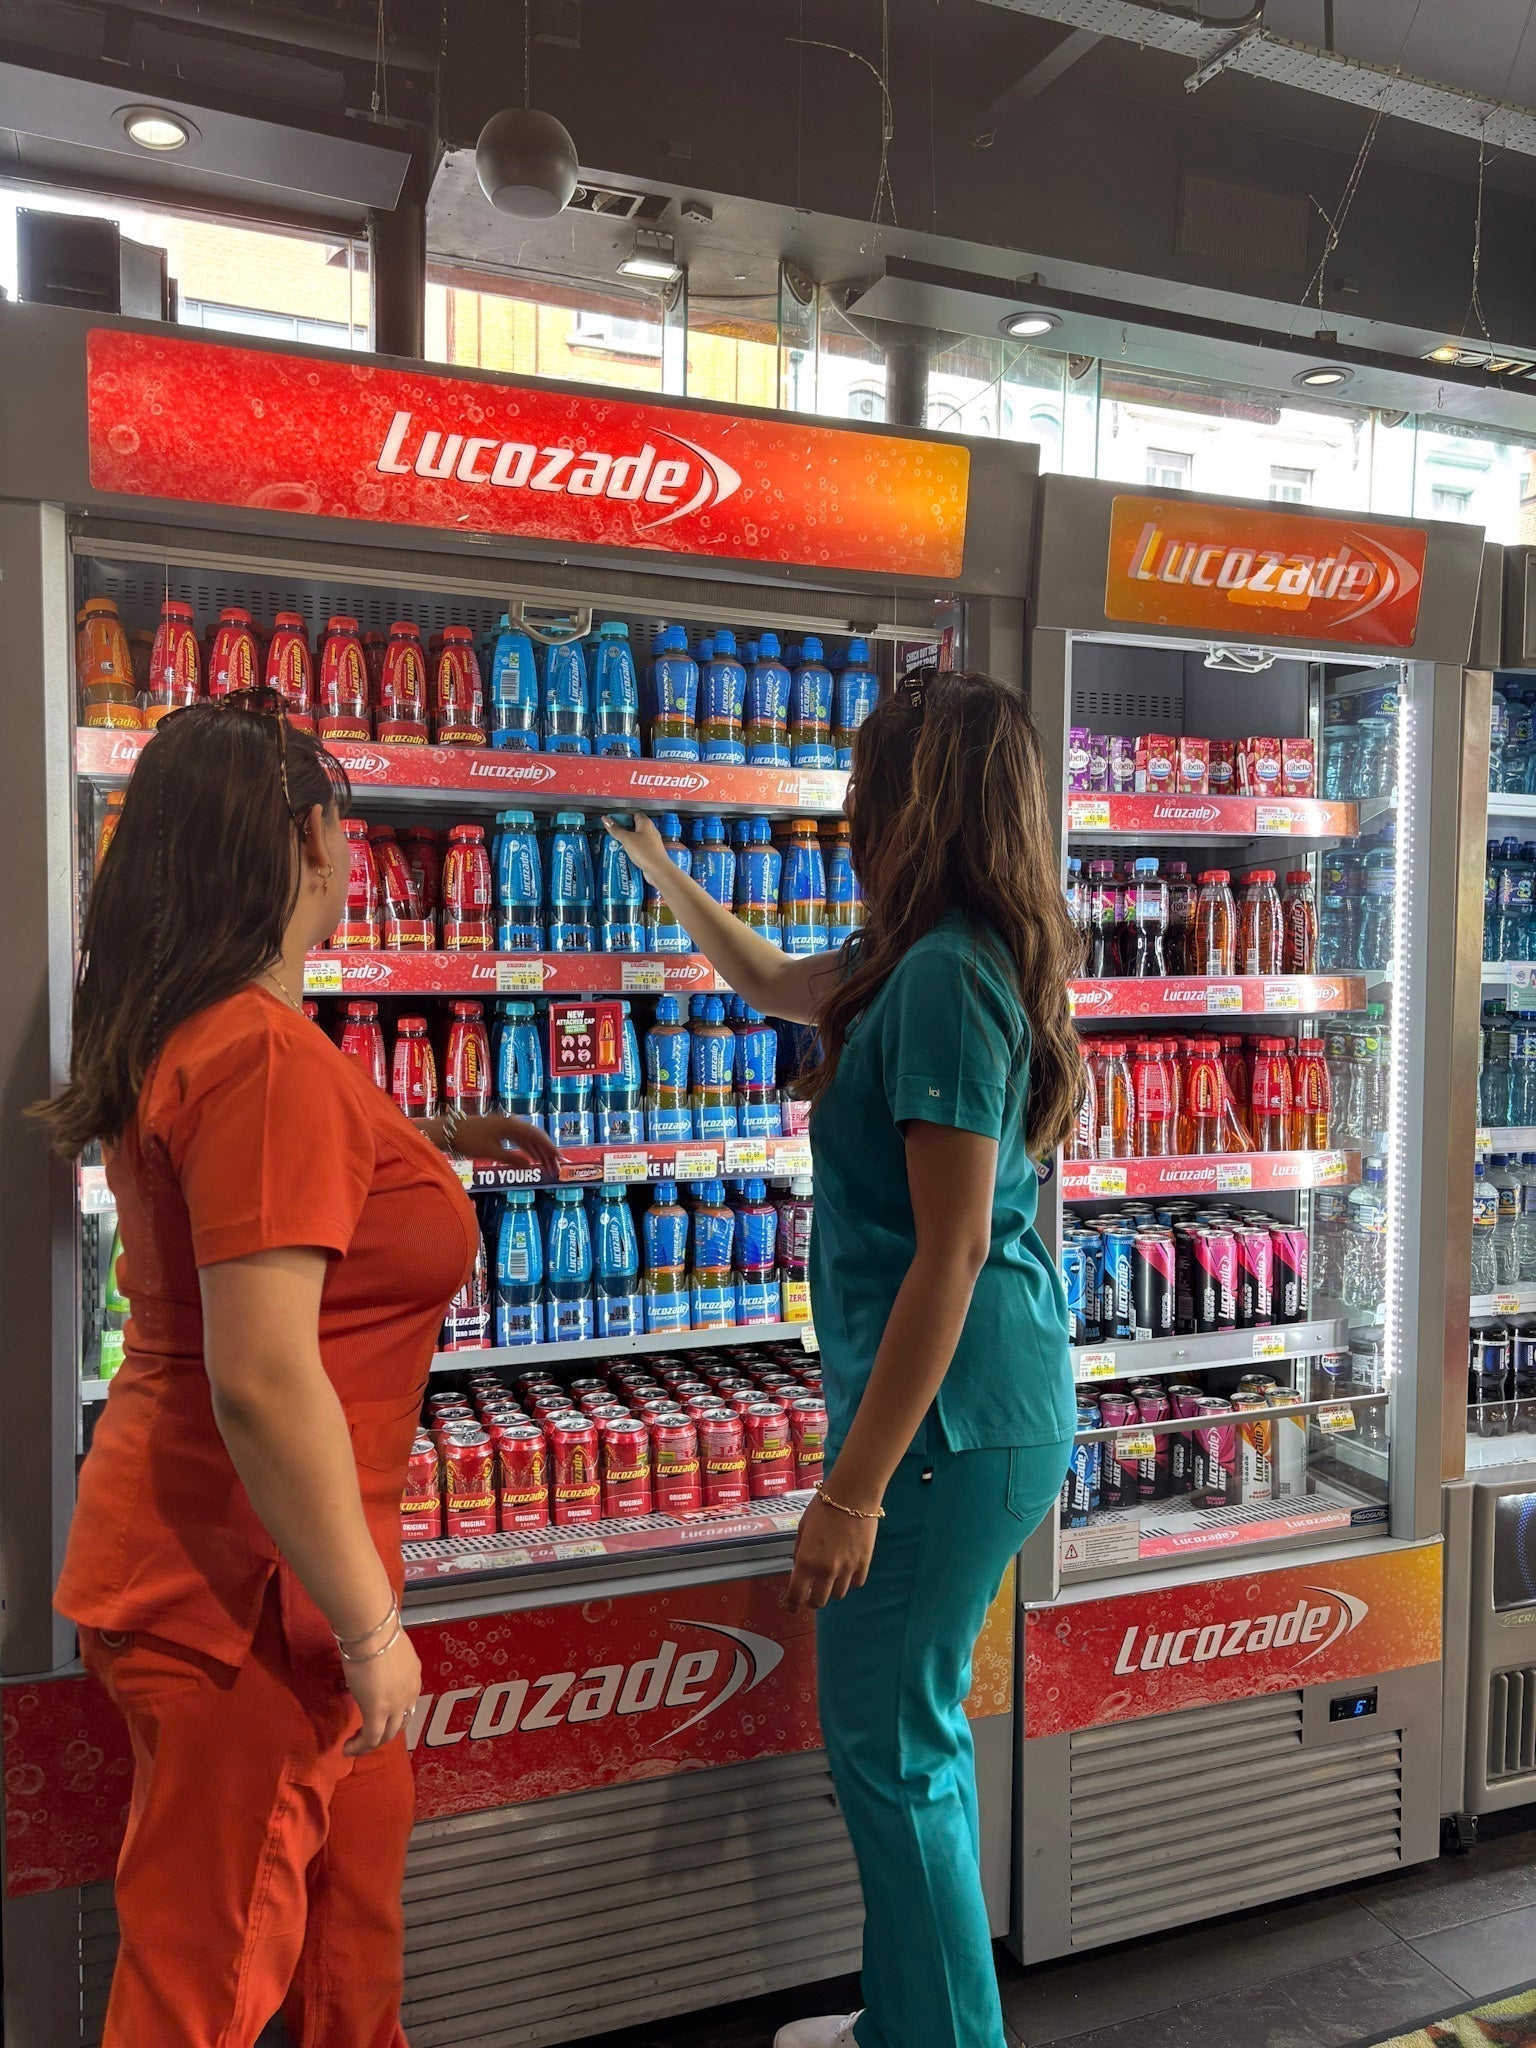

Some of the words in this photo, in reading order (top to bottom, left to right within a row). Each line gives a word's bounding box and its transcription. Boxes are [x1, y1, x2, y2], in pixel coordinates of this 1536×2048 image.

[375, 410, 686, 505] Lucozade
[1127, 521, 1378, 602] Lucozade
[322, 729, 366, 741] Lucozade
[381, 733, 424, 744] Lucozade
[439, 730, 482, 742] Lucozade
[656, 749, 697, 760] Lucozade
[702, 752, 744, 763] Lucozade
[750, 755, 791, 768] Lucozade
[794, 756, 834, 767] Lucozade
[1149, 760, 1171, 771] Ribena
[1183, 761, 1205, 772] Ribena
[1257, 761, 1279, 772] Ribena
[1286, 761, 1312, 772] Ribena
[470, 760, 543, 780] Lucozade
[1208, 764, 1231, 775] Ribena
[629, 770, 698, 788] Lucozade
[1154, 804, 1210, 819] Lucozade
[522, 852, 532, 897] Lucozade
[562, 851, 574, 896] Lucozade
[620, 852, 630, 896] Lucozade
[787, 937, 826, 947] Lucozade
[1292, 910, 1304, 967] Lucozade
[566, 1010, 585, 1019] NEW
[556, 1018, 583, 1026] ATTACHED
[467, 1041, 476, 1087] Lucozade
[710, 1044, 719, 1084] Lucozade
[742, 1116, 779, 1126] Lucozade
[477, 1171, 494, 1185] TO
[497, 1168, 541, 1184] YOURS
[1160, 1167, 1215, 1182] Lucozade
[567, 1229, 578, 1273] Lucozade
[612, 1224, 623, 1268] Lucozade
[1085, 1264, 1095, 1321] Lucozade
[1115, 1262, 1129, 1318] Lucozade
[1218, 1264, 1232, 1319] Lucozade
[1255, 1260, 1267, 1316] Lucozade
[695, 1298, 733, 1309] Lucozade
[738, 1294, 777, 1305] Lucozade
[444, 1314, 487, 1328] Lucozade
[751, 1447, 789, 1460] Lucozade
[798, 1451, 825, 1462] Lucoz
[1253, 1431, 1265, 1482] Lucozade
[657, 1461, 697, 1474] Lucozade
[706, 1457, 745, 1470] Lucozade
[1206, 1436, 1219, 1488] Lucozade
[606, 1466, 648, 1480] Lucozade
[1112, 1462, 1122, 1488] ALERT
[1217, 1467, 1227, 1492] ALERT
[763, 1477, 787, 1485] ORIGINAL
[1072, 1456, 1086, 1511] Lucozade
[503, 1490, 545, 1503] Lucozade
[555, 1485, 597, 1498] Lucozade
[669, 1492, 693, 1501] ORIGINAL
[718, 1489, 741, 1497] ORIGINAL
[400, 1497, 435, 1512] ucozade
[449, 1496, 491, 1508] Lucozade
[618, 1499, 643, 1508] ORIGINAL
[515, 1513, 540, 1522] ORIGINAL
[567, 1508, 592, 1517] ORIGINAL
[402, 1523, 429, 1531] ORIGINAL
[460, 1520, 486, 1528] ORIGINAL
[1286, 1513, 1339, 1529] Lucozade
[681, 1524, 752, 1539] Lucozade
[1173, 1531, 1228, 1546] Lucozade
[1113, 1599, 1336, 1676] Lucozade
[408, 1640, 720, 1750] cozade
